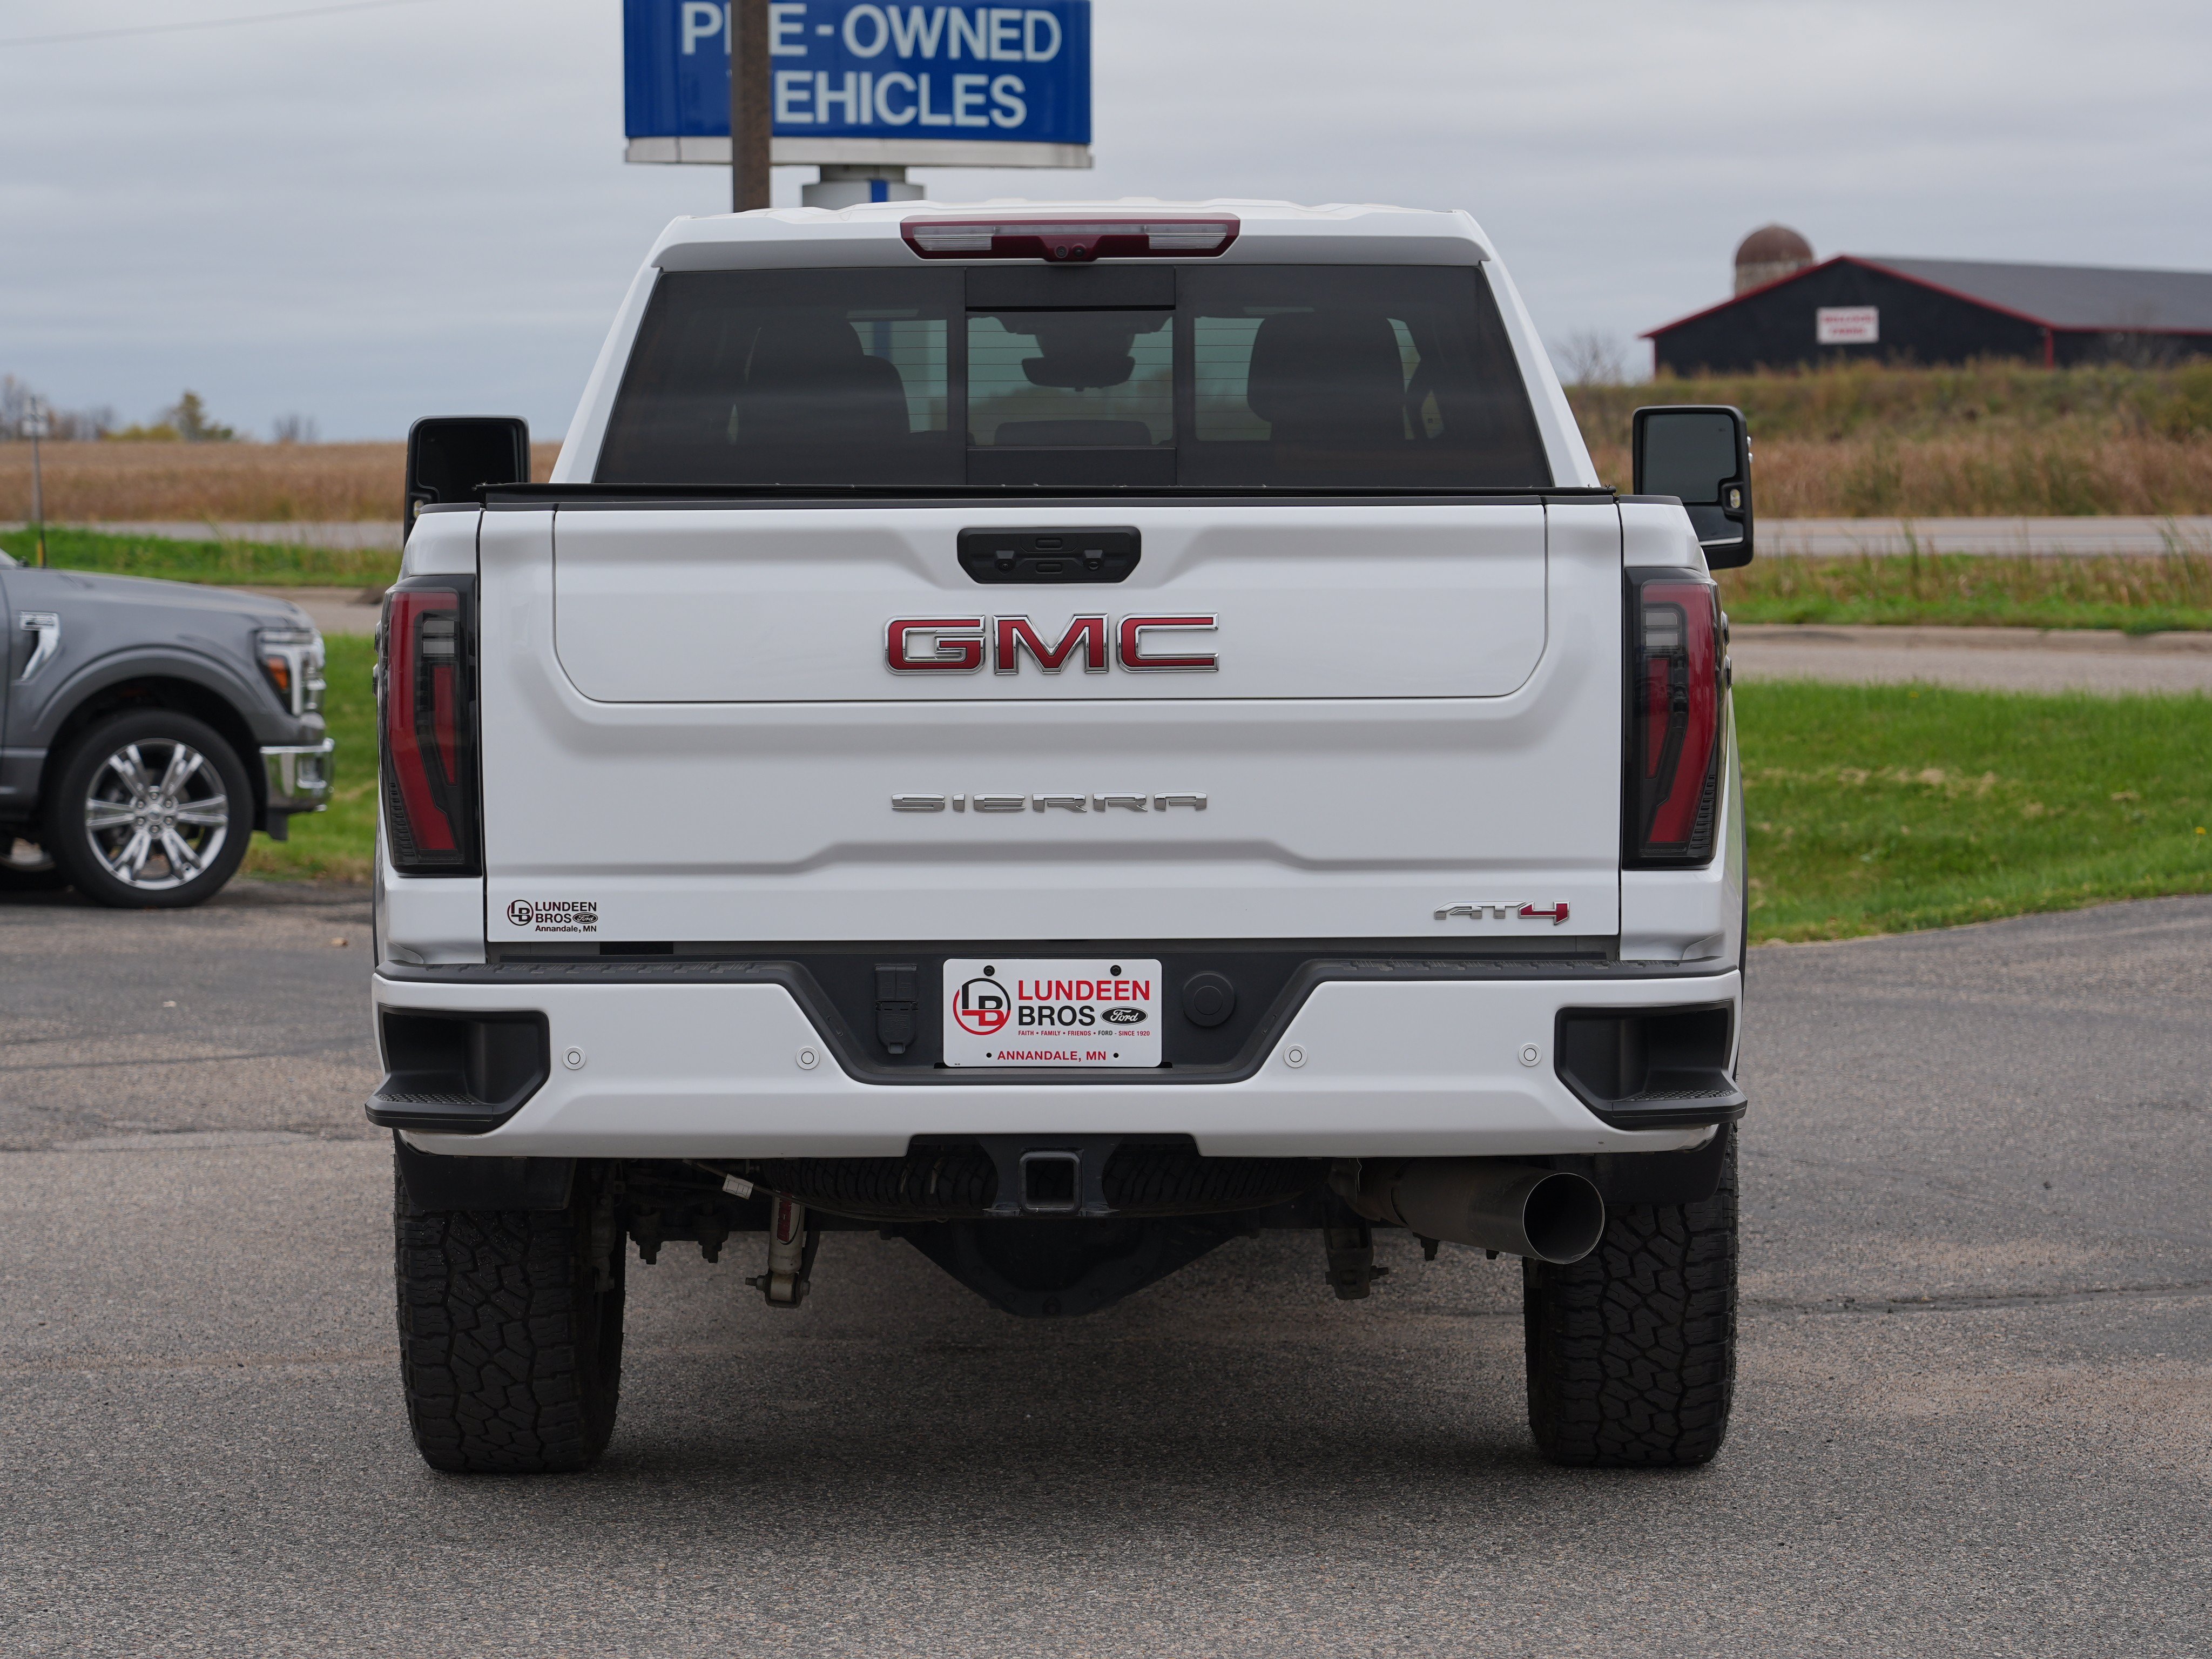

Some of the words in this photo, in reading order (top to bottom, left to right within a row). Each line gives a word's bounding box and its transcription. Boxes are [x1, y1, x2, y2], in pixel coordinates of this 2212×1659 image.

[682, 1, 1062, 63] PE-OWNED
[726, 69, 1027, 129] EHICLES
[885, 612, 1219, 675] GMC
[892, 792, 1208, 813] SIERRA
[535, 901, 597, 912] LUNDEEN
[1434, 900, 1570, 926] AT4
[535, 913, 572, 923] BROS
[576, 914, 595, 923] Ford
[535, 925, 581, 933] Annandale,
[1018, 980, 1150, 1001] LUNDEEN
[1018, 1005, 1096, 1027] BROS
[1108, 1008, 1139, 1023] Ford
[997, 1050, 1081, 1062] ANNANDALE,
[1086, 1050, 1107, 1061] MN
